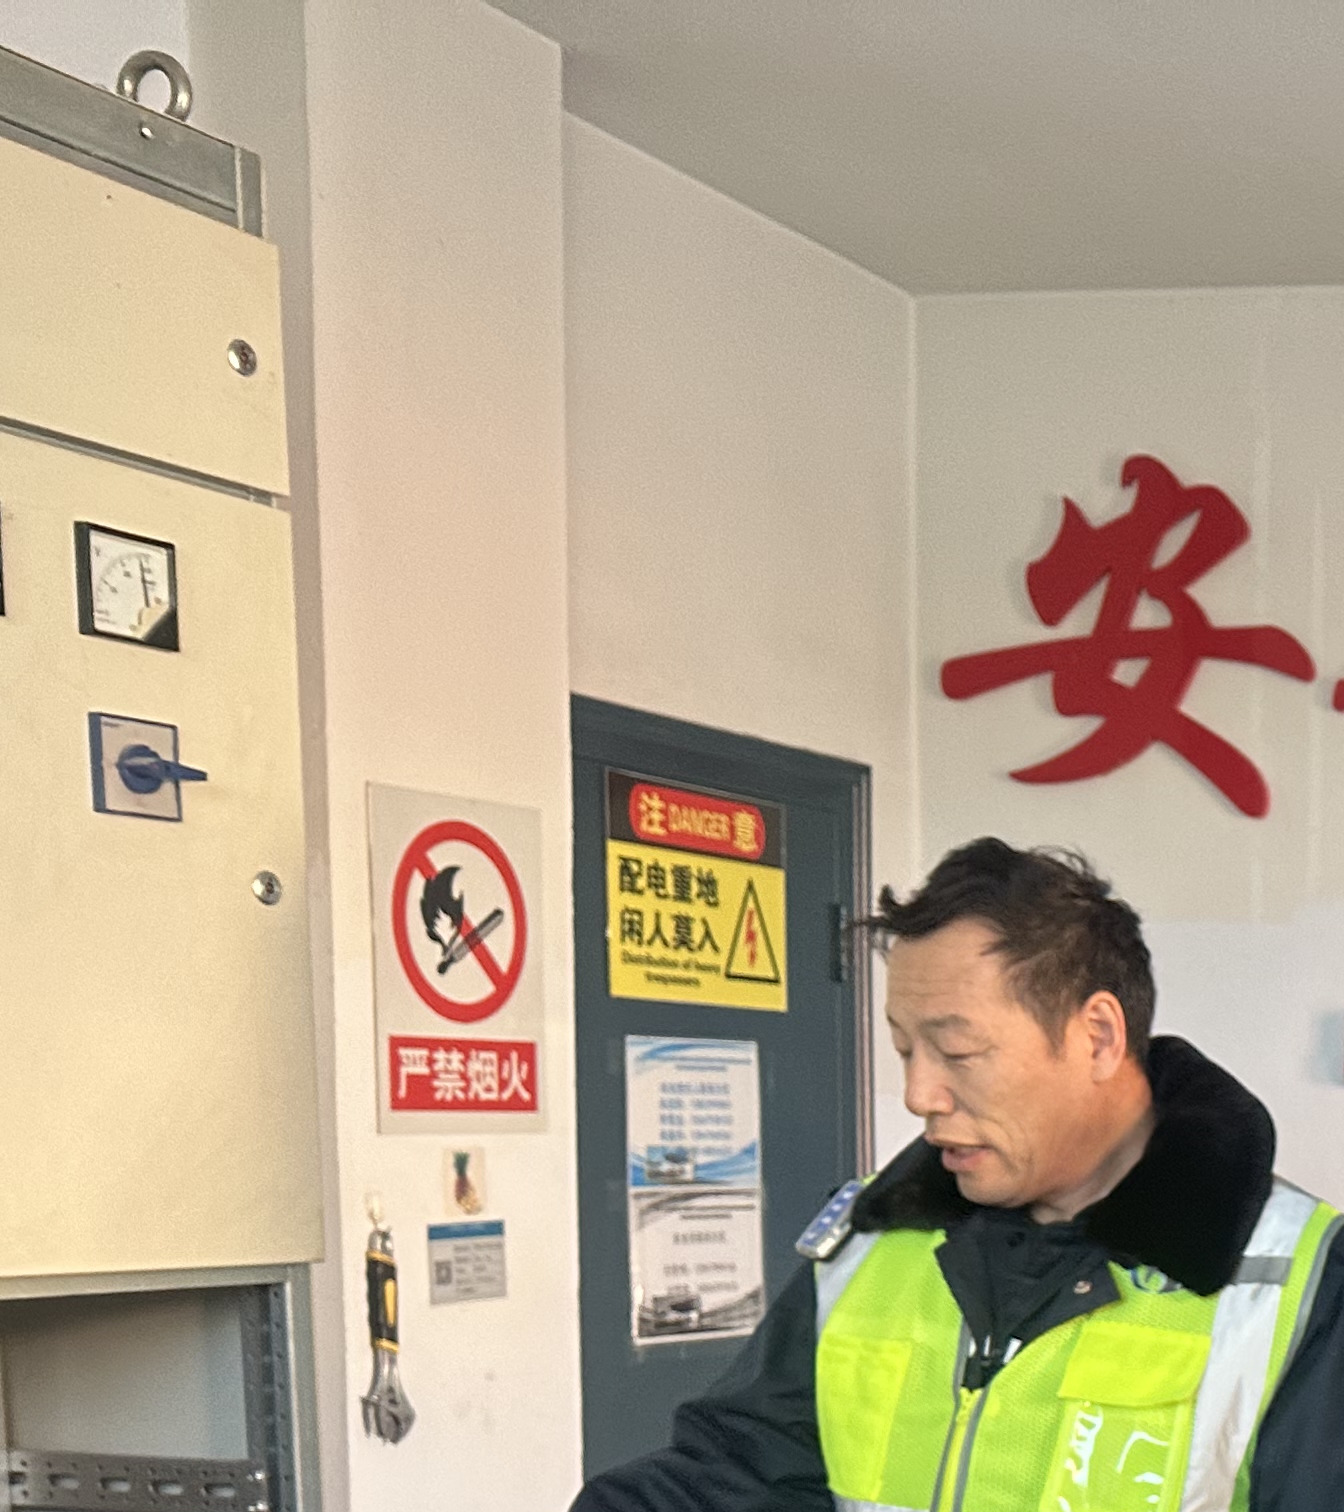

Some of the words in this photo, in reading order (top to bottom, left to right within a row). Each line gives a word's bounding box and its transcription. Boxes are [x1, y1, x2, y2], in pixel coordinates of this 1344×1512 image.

[638, 791, 668, 836] 注
[668, 802, 731, 840] DANGER
[731, 809, 759, 853] 意
[618, 855, 720, 908] 配电重地
[619, 904, 720, 954] 闲人莫入
[396, 1046, 532, 1103] 严禁烟火
